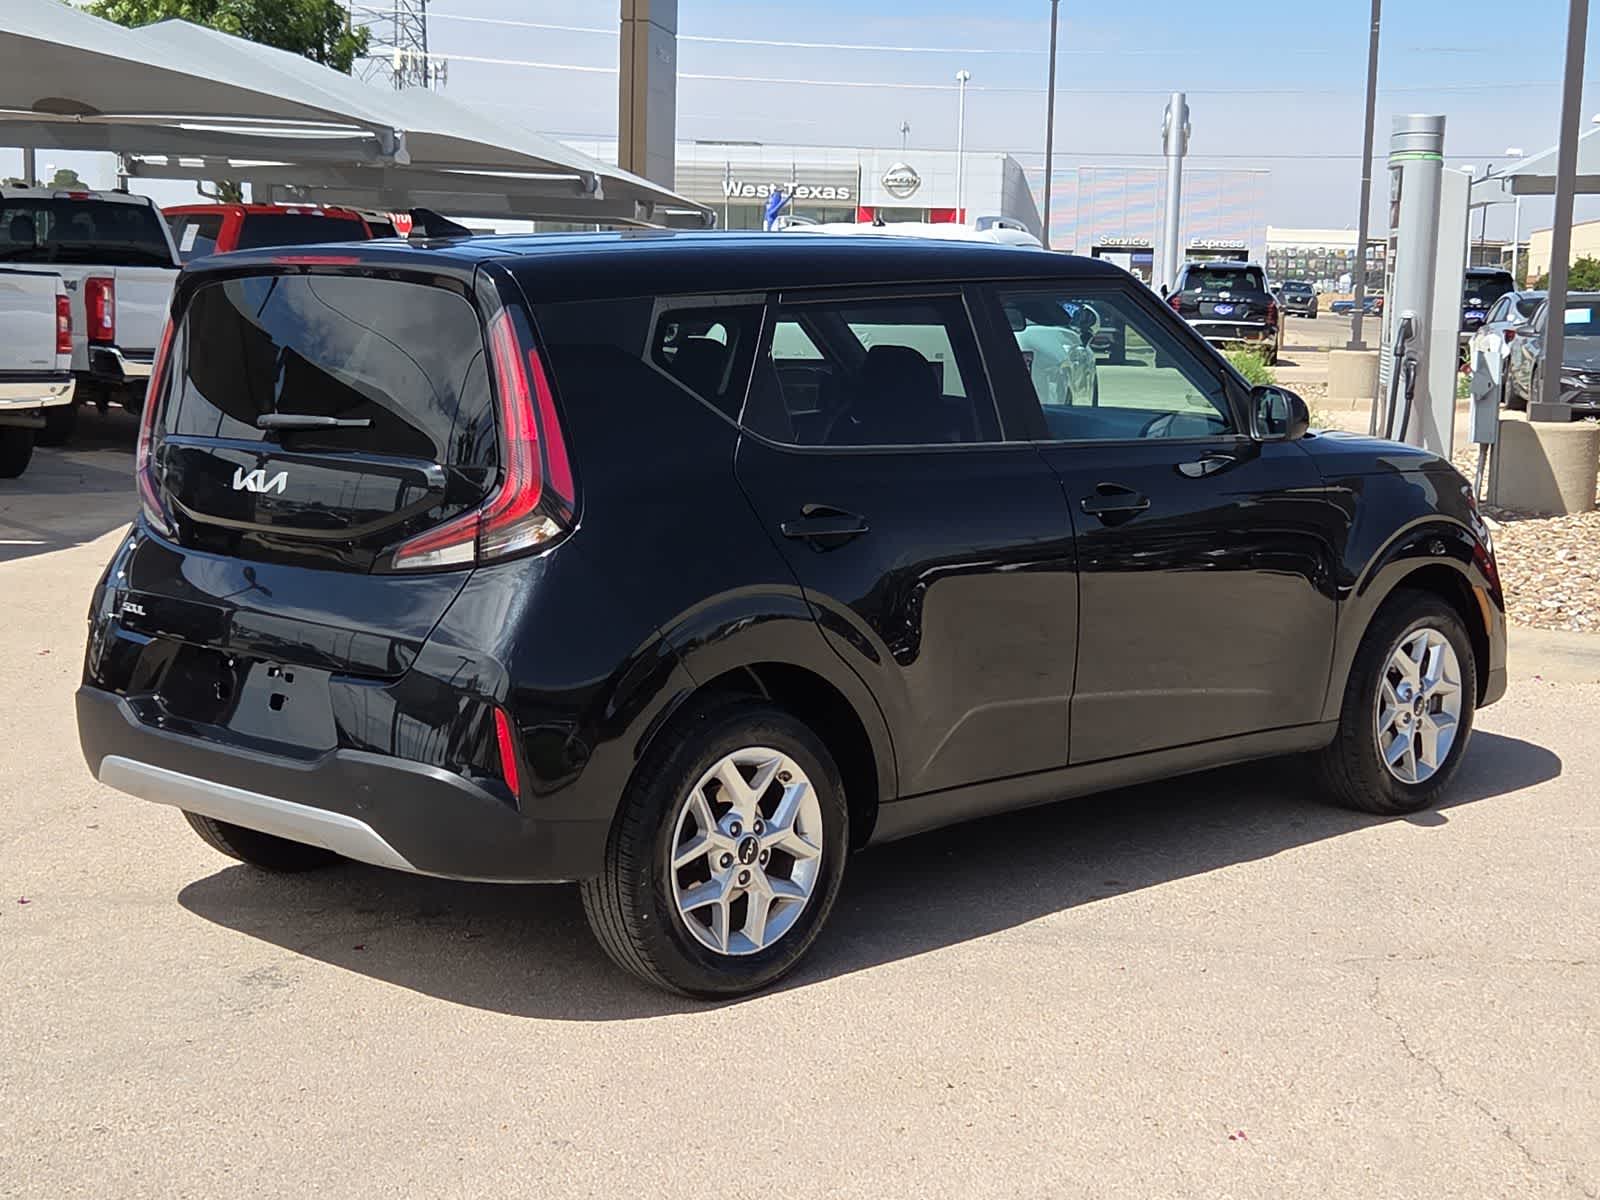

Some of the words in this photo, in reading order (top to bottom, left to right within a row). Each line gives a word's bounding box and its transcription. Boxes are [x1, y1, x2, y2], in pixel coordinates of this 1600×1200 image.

[722, 180, 776, 198] West
[783, 182, 850, 200] Texas
[1099, 235, 1149, 246] Service
[1191, 237, 1245, 249] Express
[232, 467, 288, 494] KIA
